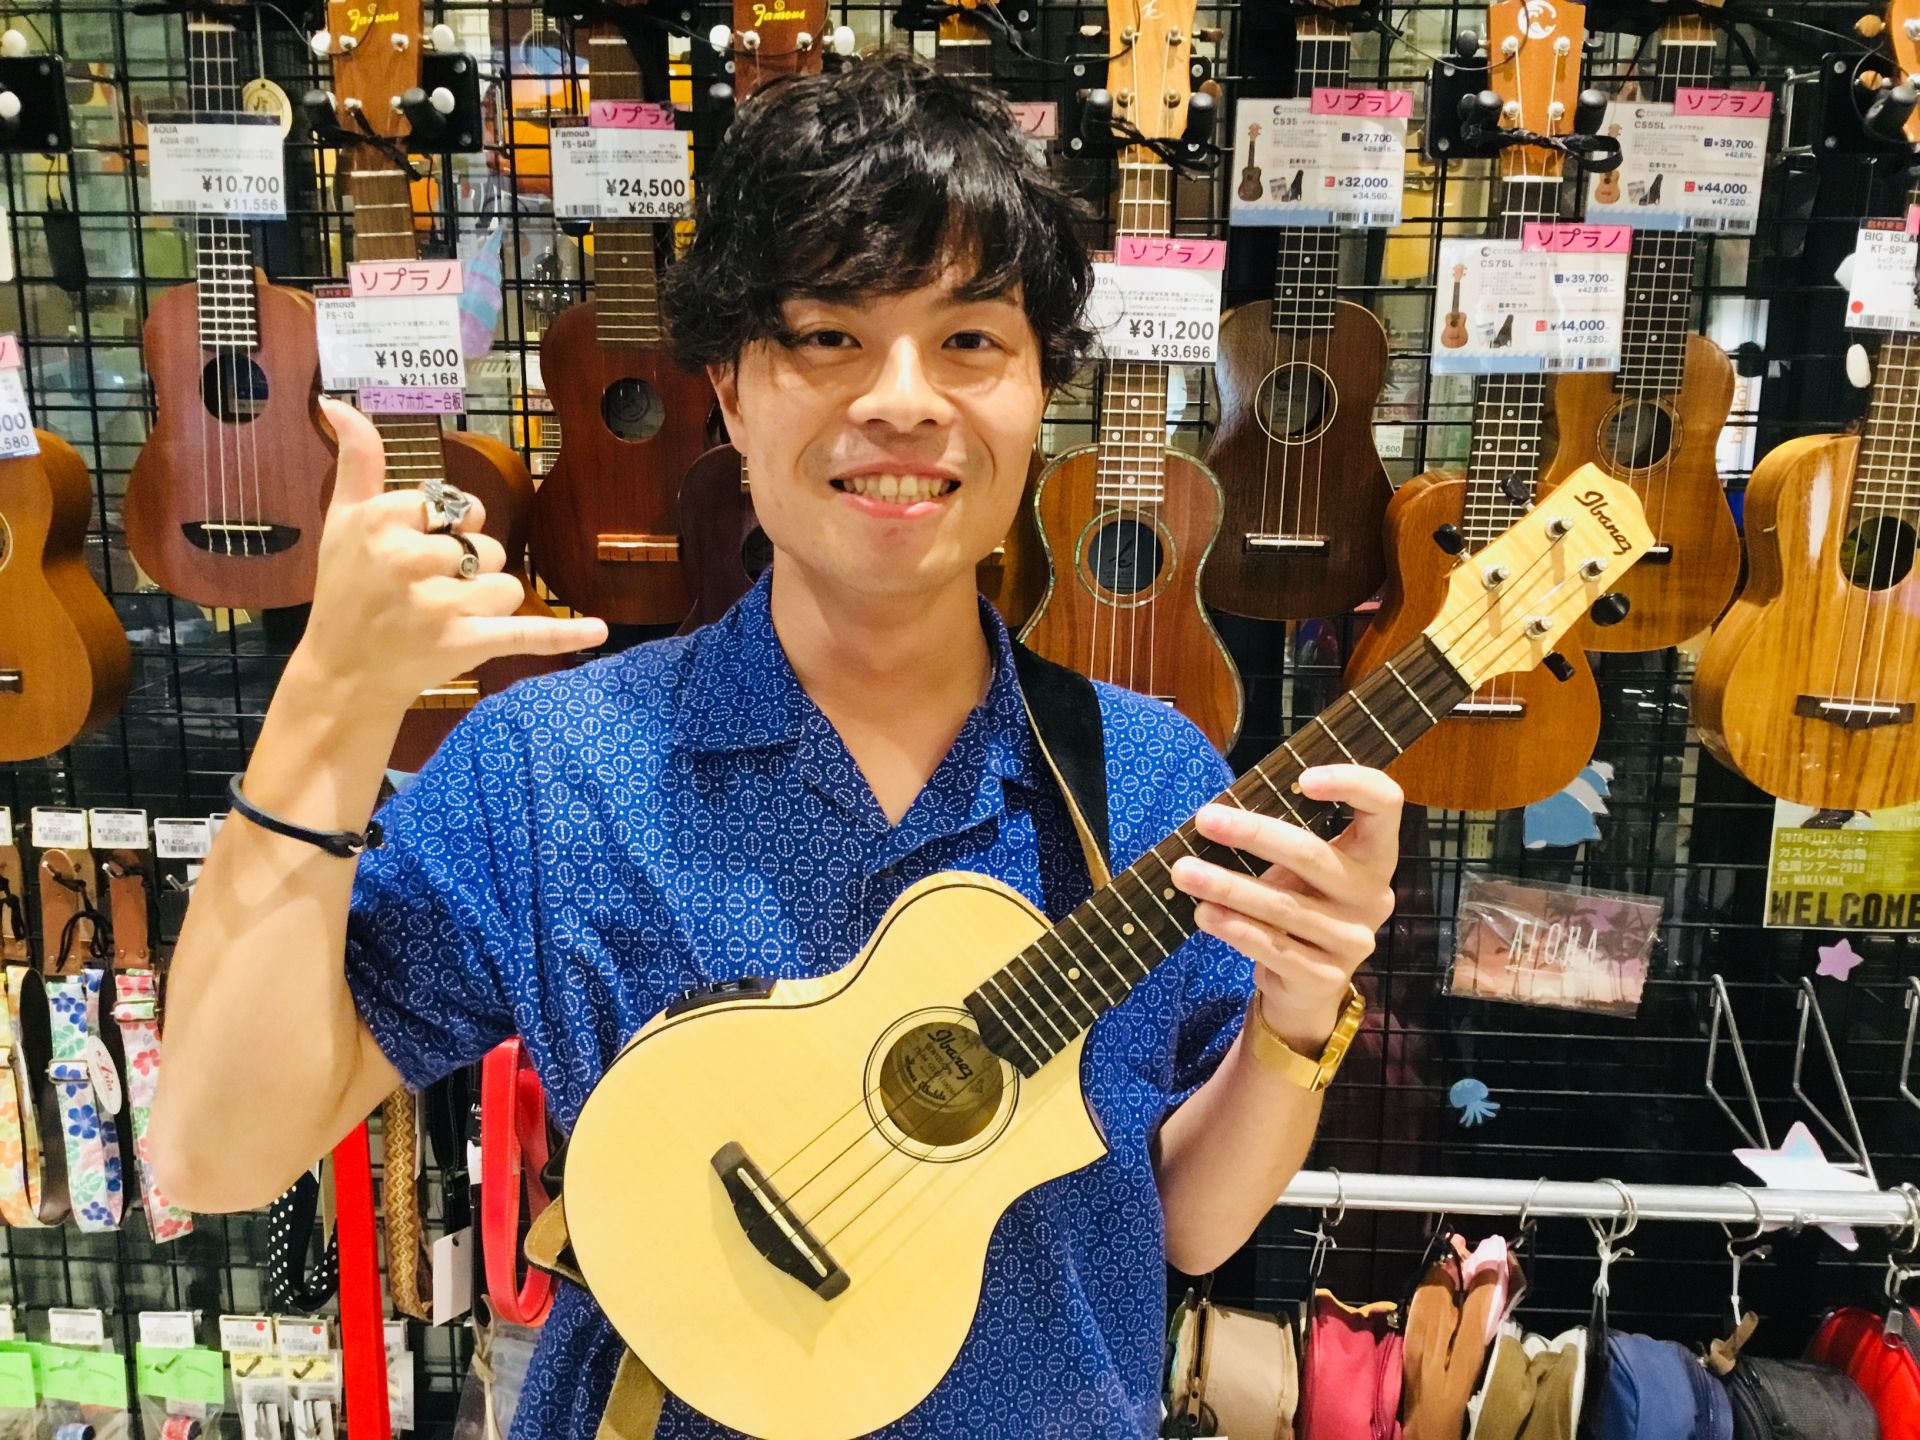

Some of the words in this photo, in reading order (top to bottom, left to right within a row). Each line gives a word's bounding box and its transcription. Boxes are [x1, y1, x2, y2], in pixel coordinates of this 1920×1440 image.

[346, 9, 399, 32] Famous
[753, 4, 806, 27] Famous
[1324, 92, 1404, 113] ソプラノ
[1687, 93, 1764, 113] ソプラノ
[1352, 132, 1392, 143] ¥27,700
[1714, 139, 1753, 149] ¥39,700
[202, 175, 280, 194] ¥10,700
[606, 178, 685, 198] ¥24,500
[1338, 177, 1388, 189] ¥32,000
[1698, 182, 1747, 194] ¥44,000
[224, 198, 279, 211] ¥11,556
[628, 202, 685, 215] ¥26,460
[1537, 227, 1621, 248] ソプラノ
[1865, 232, 1883, 242] BIG
[1891, 233, 1917, 244] ISLA
[1130, 243, 1214, 264] ソプラノ
[361, 267, 452, 291] ソプラノ
[1565, 274, 1609, 284] ¥39,700
[318, 301, 356, 309] Famous
[1129, 319, 1215, 340] ¥31,200
[1551, 319, 1605, 332] ¥44,000
[375, 349, 459, 368] ¥19,600
[1151, 343, 1211, 359] ¥33,696
[400, 373, 459, 386] ¥21,168
[1574, 491, 1632, 555] Ibanez
[1776, 874, 1788, 884] in
[1794, 874, 1844, 887] WAKAYAMA
[1769, 890, 1920, 928] WELCOME
[1507, 920, 1600, 967] ALOHA
[927, 1029, 974, 1081] Ibanez
